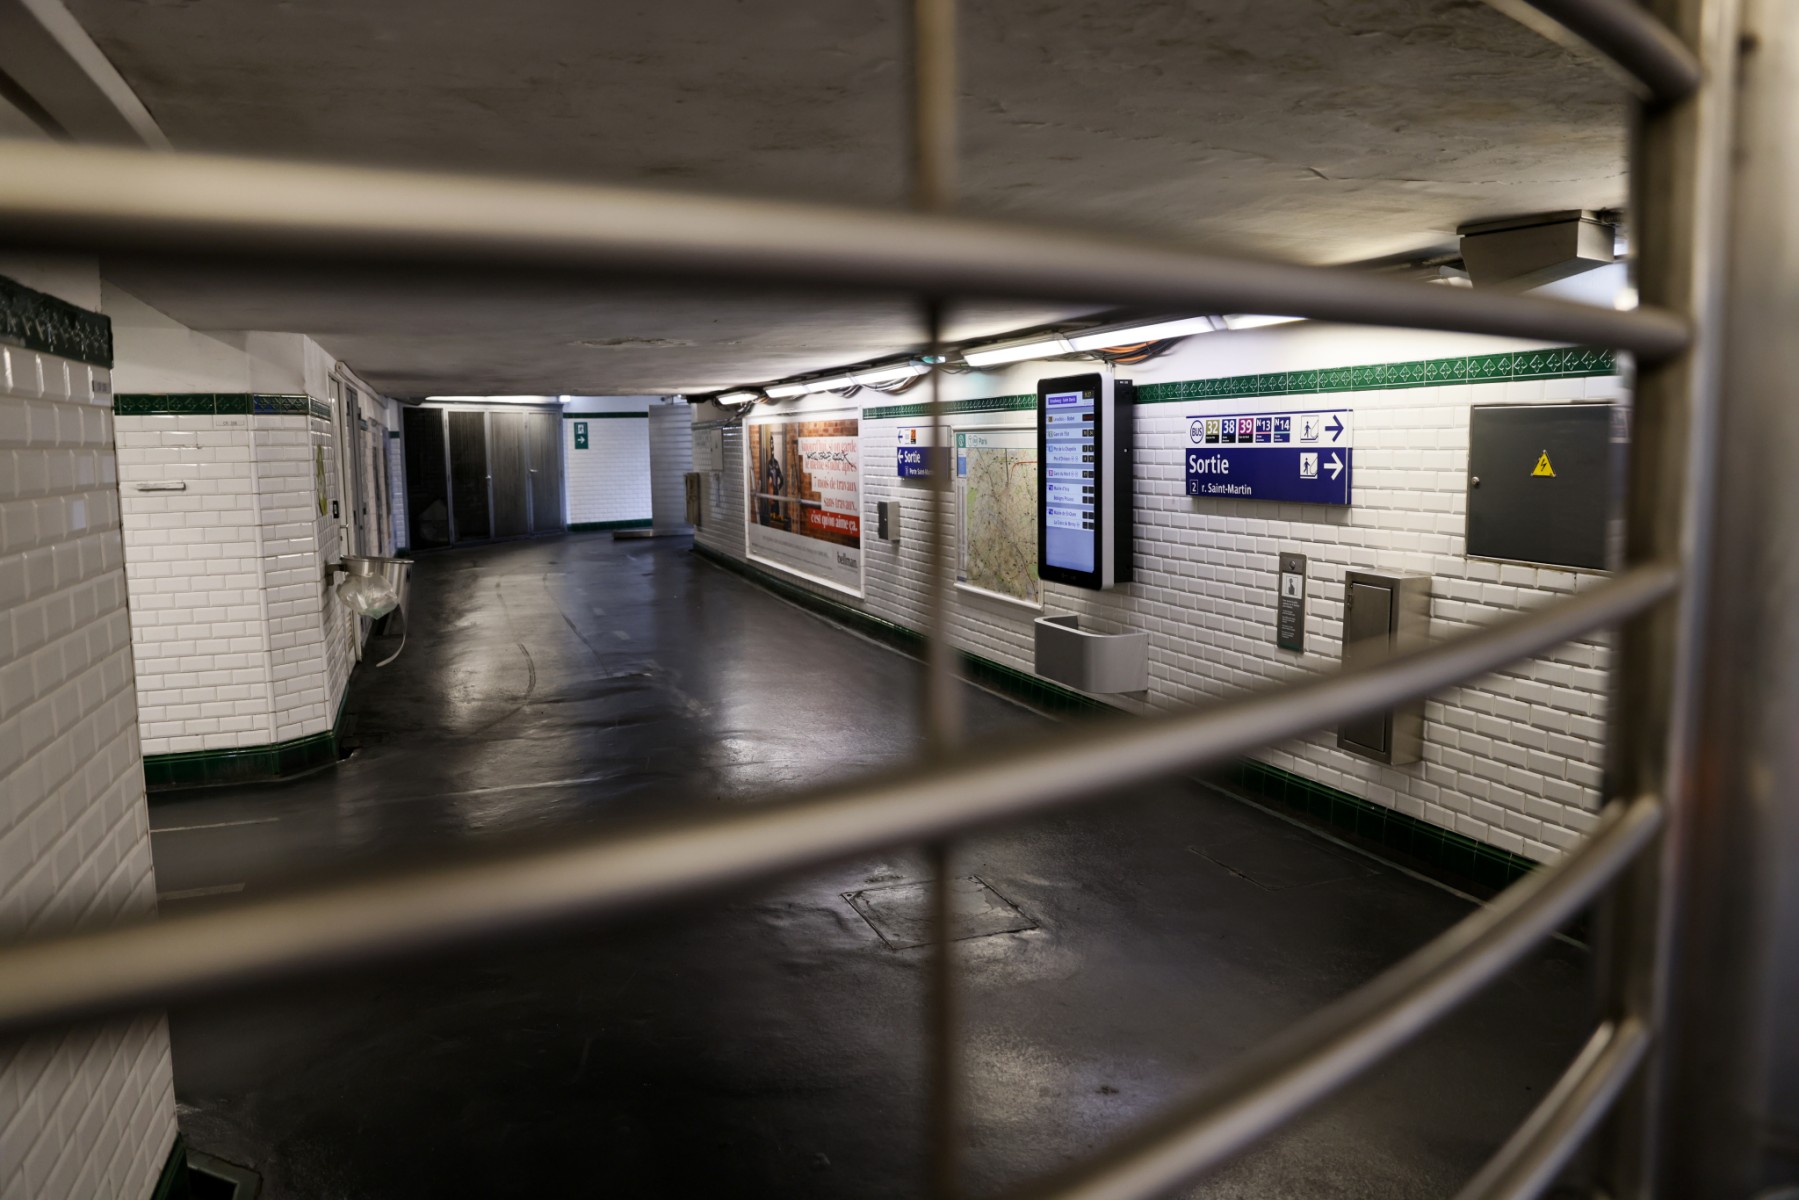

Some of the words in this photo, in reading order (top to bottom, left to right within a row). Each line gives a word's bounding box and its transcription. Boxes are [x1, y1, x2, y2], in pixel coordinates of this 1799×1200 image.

[1192, 427, 1202, 437] BUS
[1207, 420, 1218, 434] 32
[1223, 420, 1234, 434] 38
[1240, 420, 1252, 434] 39
[904, 450, 920, 463] Sortie
[1189, 454, 1229, 474] Sortie
[1192, 482, 1197, 492] 2
[1202, 484, 1207, 493] r.
[1208, 482, 1252, 495] Saint-Martin
[835, 515, 848, 530] aime
